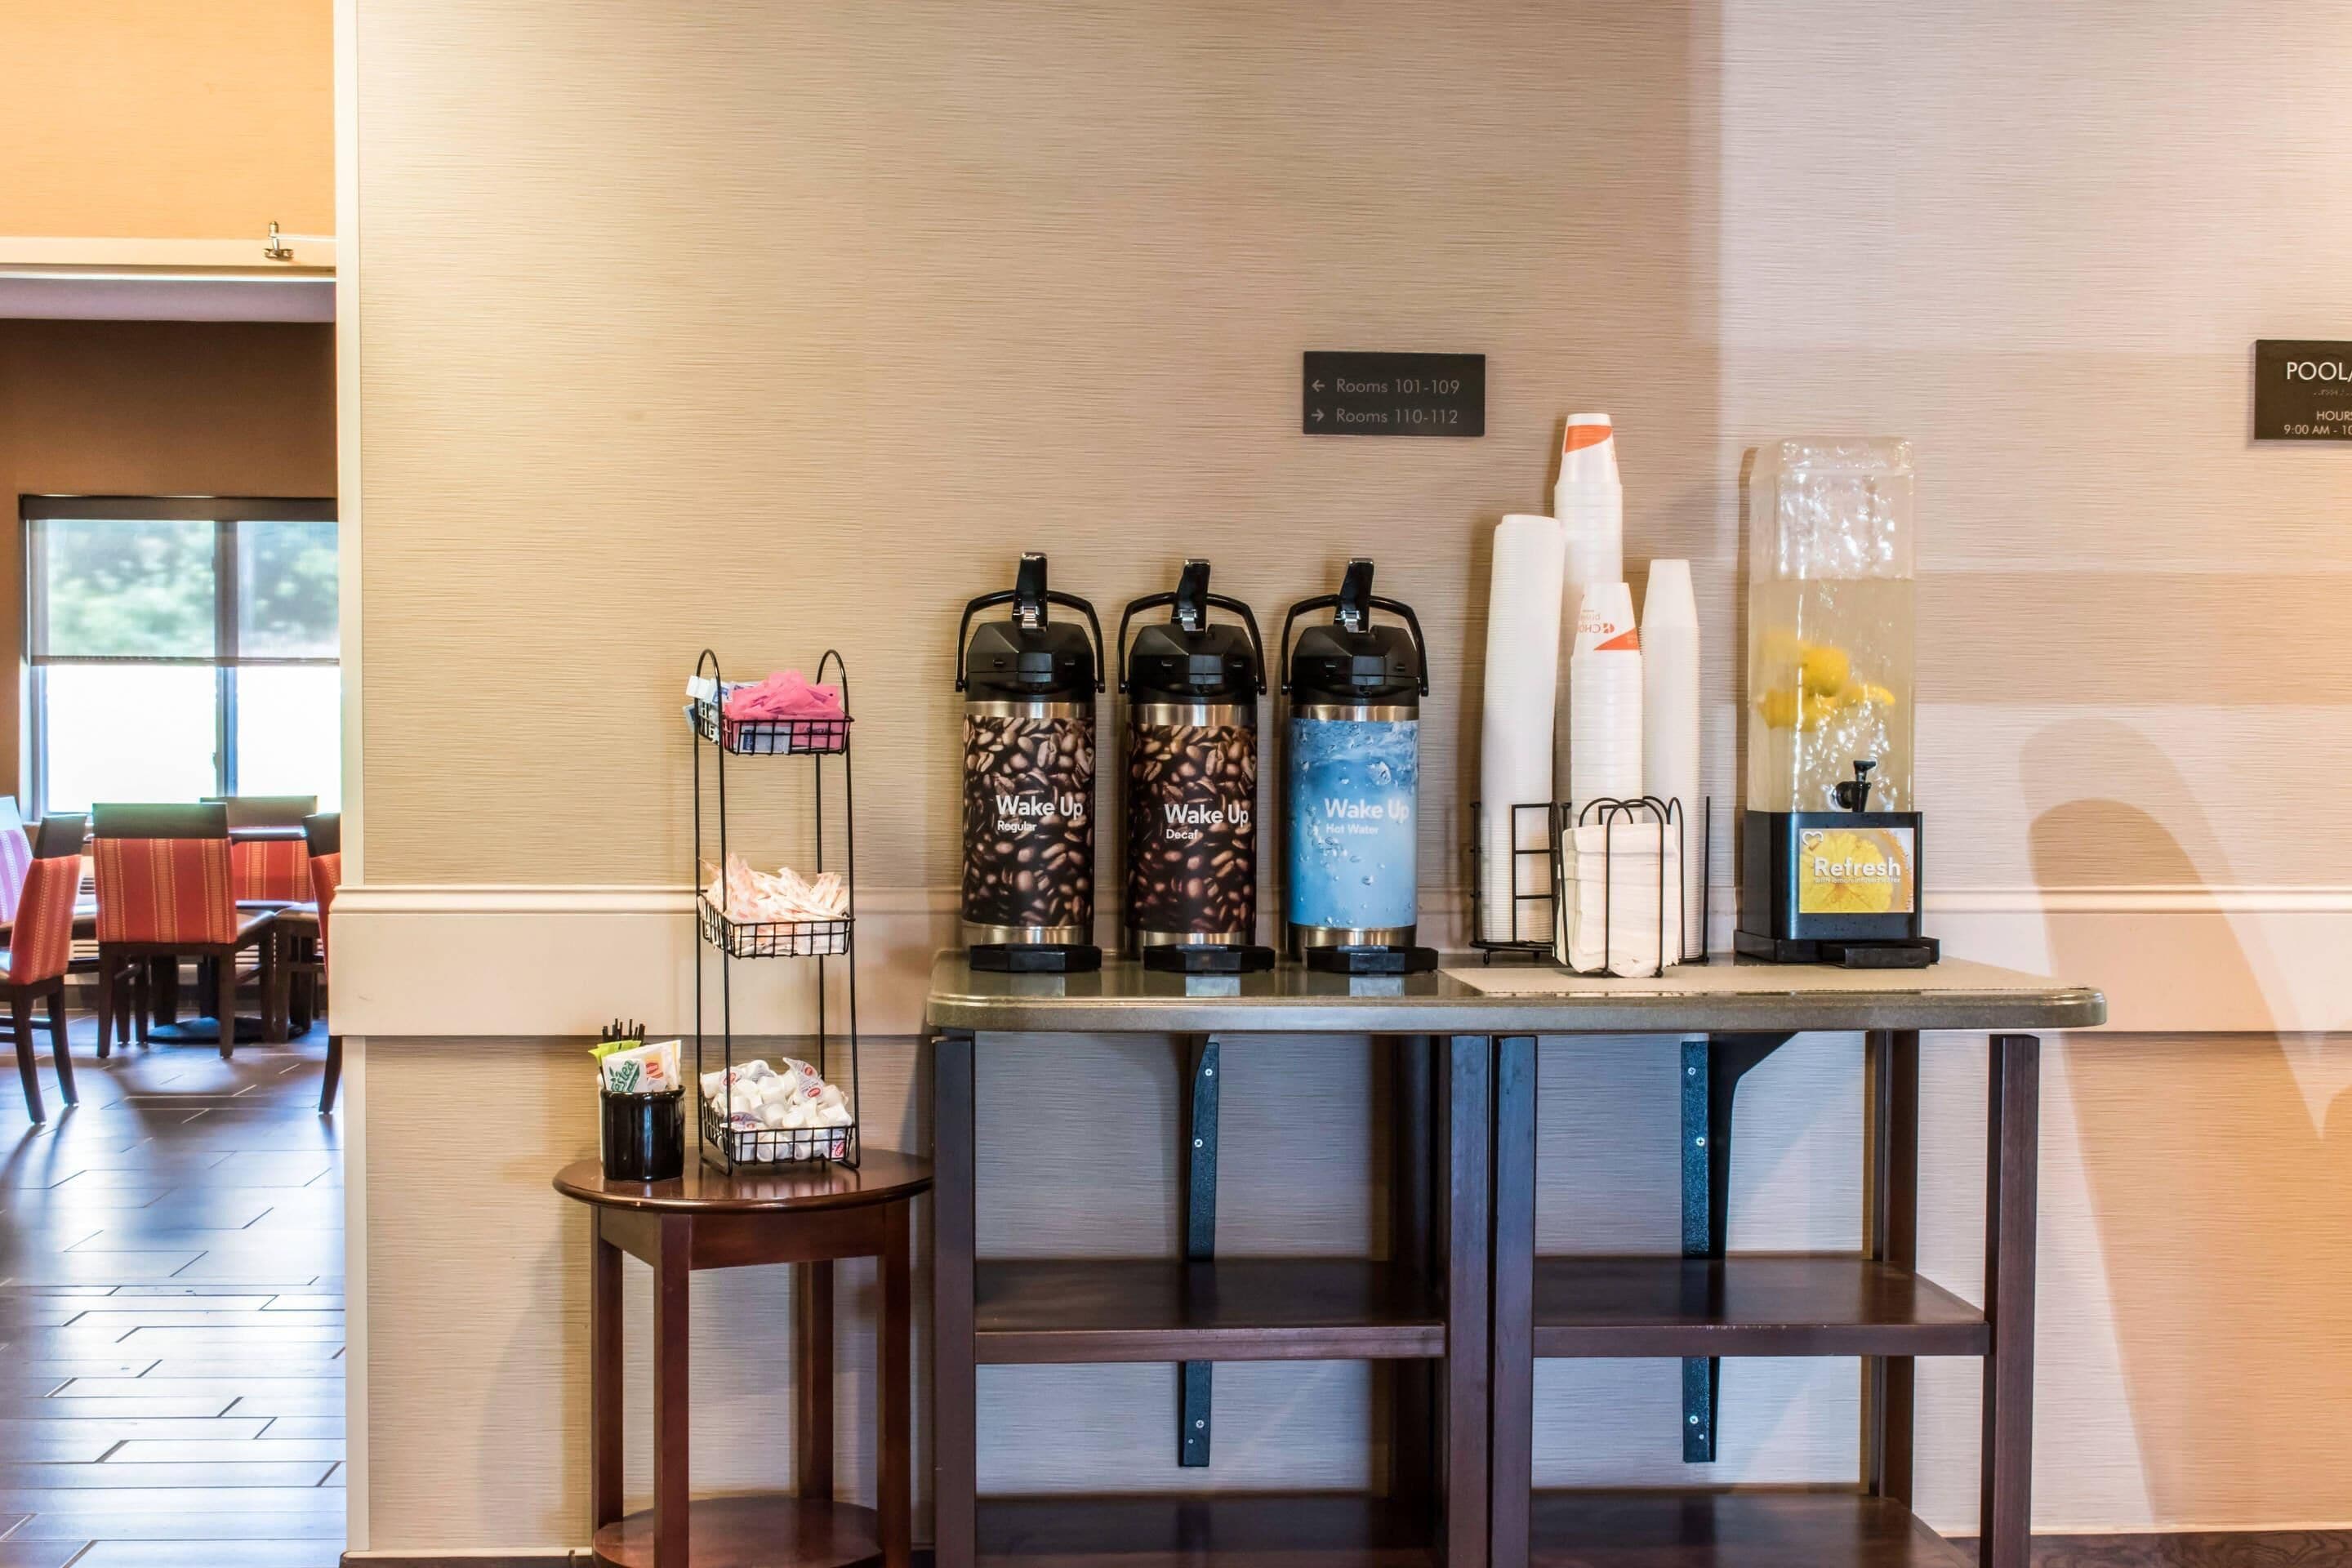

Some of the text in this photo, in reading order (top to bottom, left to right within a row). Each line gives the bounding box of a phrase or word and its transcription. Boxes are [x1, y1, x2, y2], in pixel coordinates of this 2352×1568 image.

[1336, 378, 1460, 394] Rooms 101-109
[1336, 408, 1458, 424] Rooms 110-112
[2283, 424, 2310, 435] 9:00
[2312, 425, 2331, 435] AM
[996, 795, 1083, 821] Wake Up
[1164, 803, 1249, 828] Wake Up
[1324, 798, 1410, 824] Wake Up
[997, 820, 1037, 833] Regular
[1165, 828, 1199, 840] Decaf
[1325, 823, 1379, 835] Hot Water
[1814, 857, 1901, 877] Refresh
